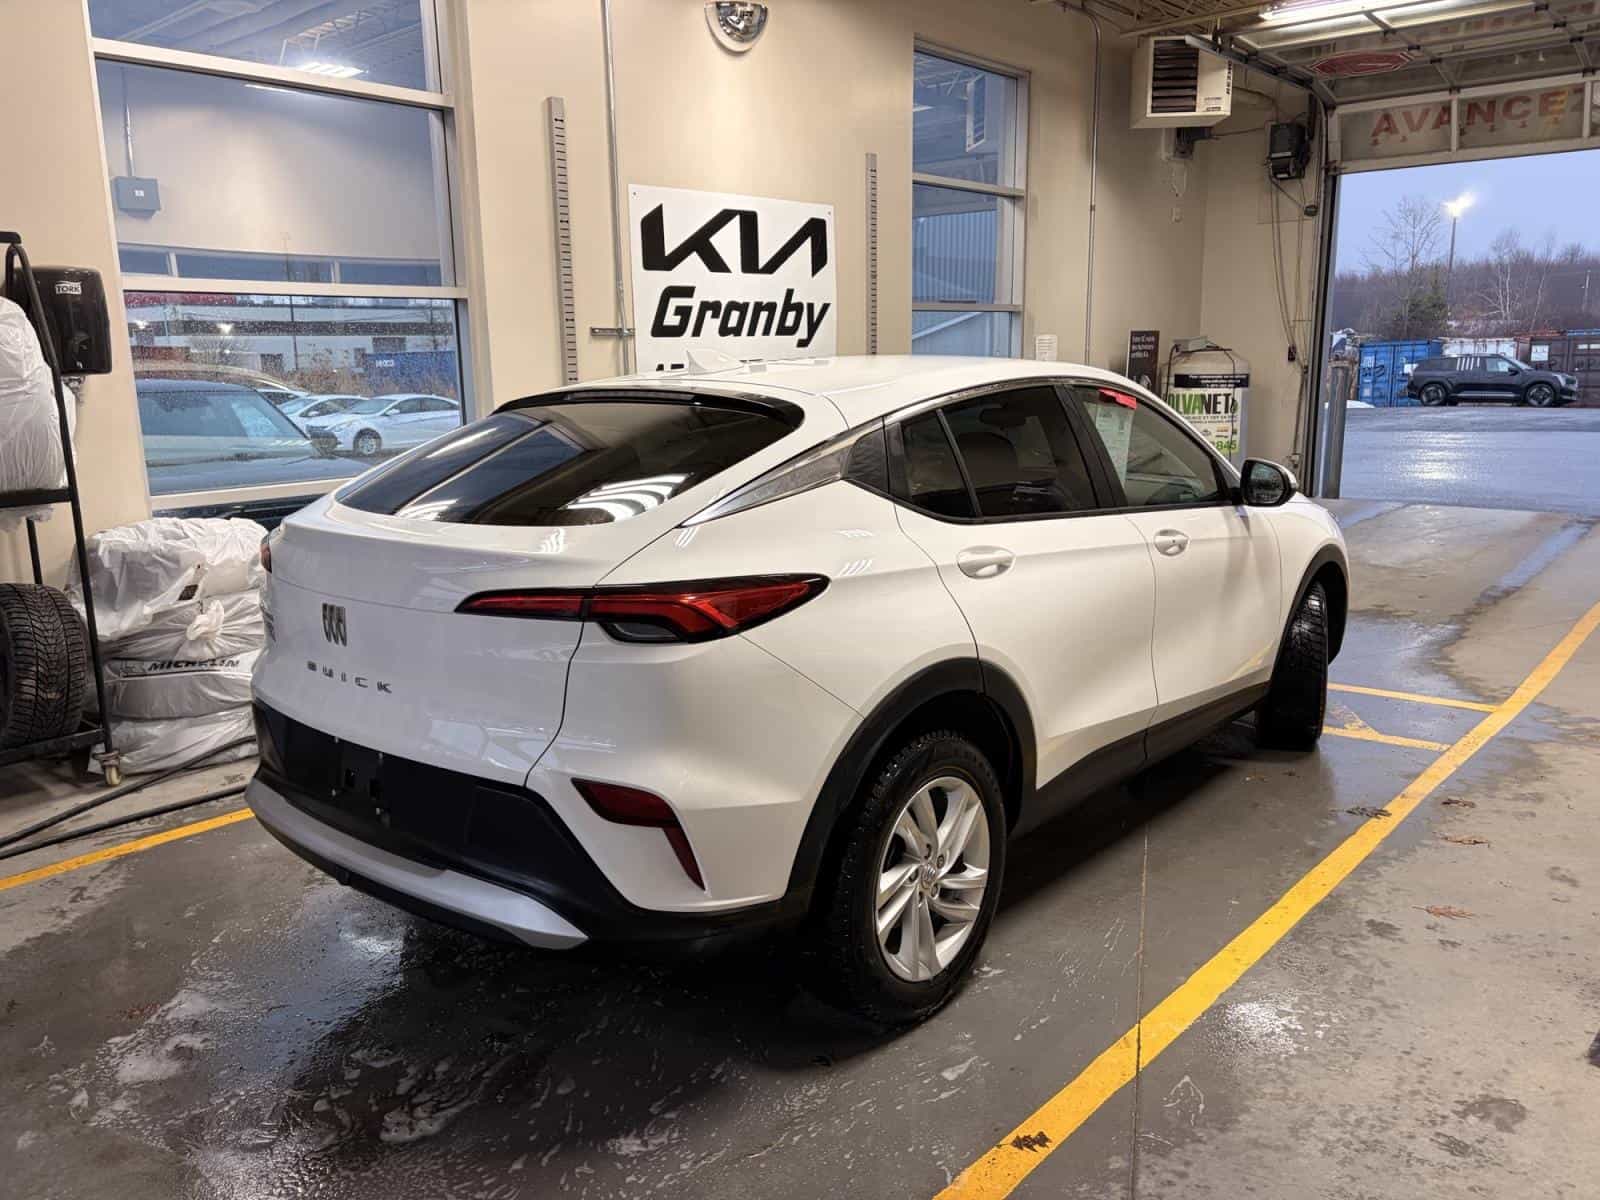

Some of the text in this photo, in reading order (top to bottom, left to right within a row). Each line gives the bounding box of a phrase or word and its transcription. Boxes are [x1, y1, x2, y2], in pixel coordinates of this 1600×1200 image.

[641, 203, 828, 278] KIA
[56, 285, 80, 293] TORK
[651, 286, 831, 348] Granby
[1164, 393, 1232, 415] OLVANET
[148, 659, 239, 672] MICHELIN
[307, 660, 392, 694] BUICK
